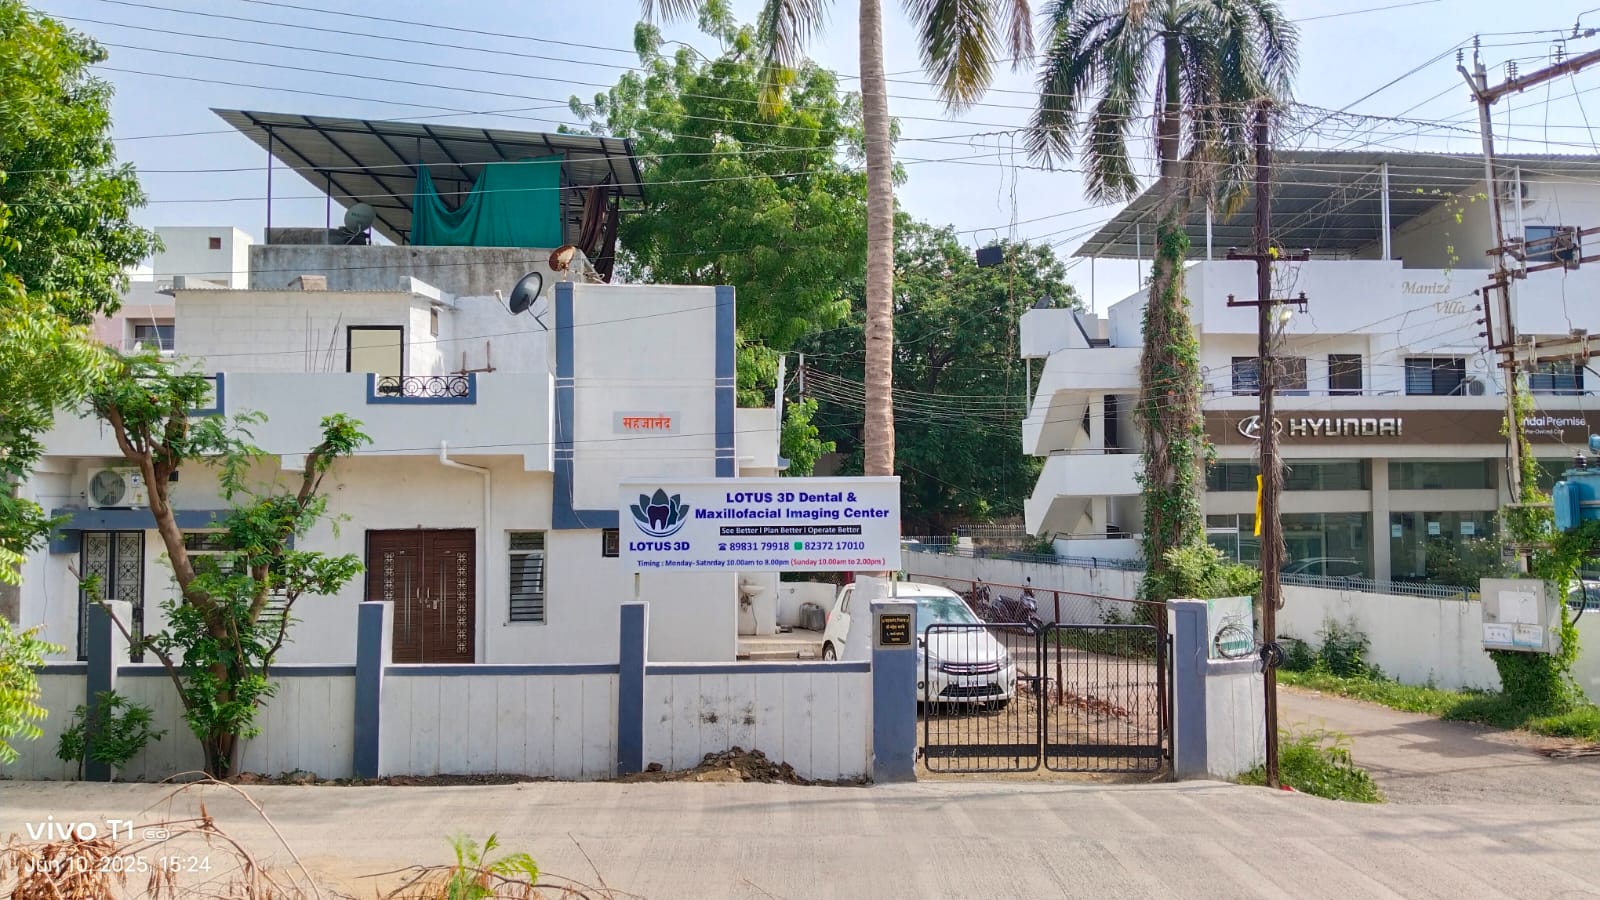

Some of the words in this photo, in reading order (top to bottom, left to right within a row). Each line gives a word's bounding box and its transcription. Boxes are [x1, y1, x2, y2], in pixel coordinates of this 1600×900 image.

[1434, 301, 1466, 314] Villa
[623, 413, 671, 431] सहजानंद
[1290, 418, 1403, 437] HYUNDAI
[726, 492, 773, 503] LOTUS
[777, 492, 795, 503] 3D
[799, 492, 843, 502] Dental
[847, 492, 857, 502] &
[695, 508, 781, 519] Maxillofacial
[786, 508, 840, 520] Imaging
[844, 507, 890, 519] Center
[736, 526, 759, 534] Better
[780, 526, 802, 534] Better
[807, 526, 836, 535] Operate
[629, 542, 671, 551] LOTUS
[673, 541, 690, 551] 3D
[761, 542, 790, 550] 79918
[804, 541, 833, 550] 82372
[836, 541, 865, 550] 17010
[818, 558, 847, 566] 10.00am
